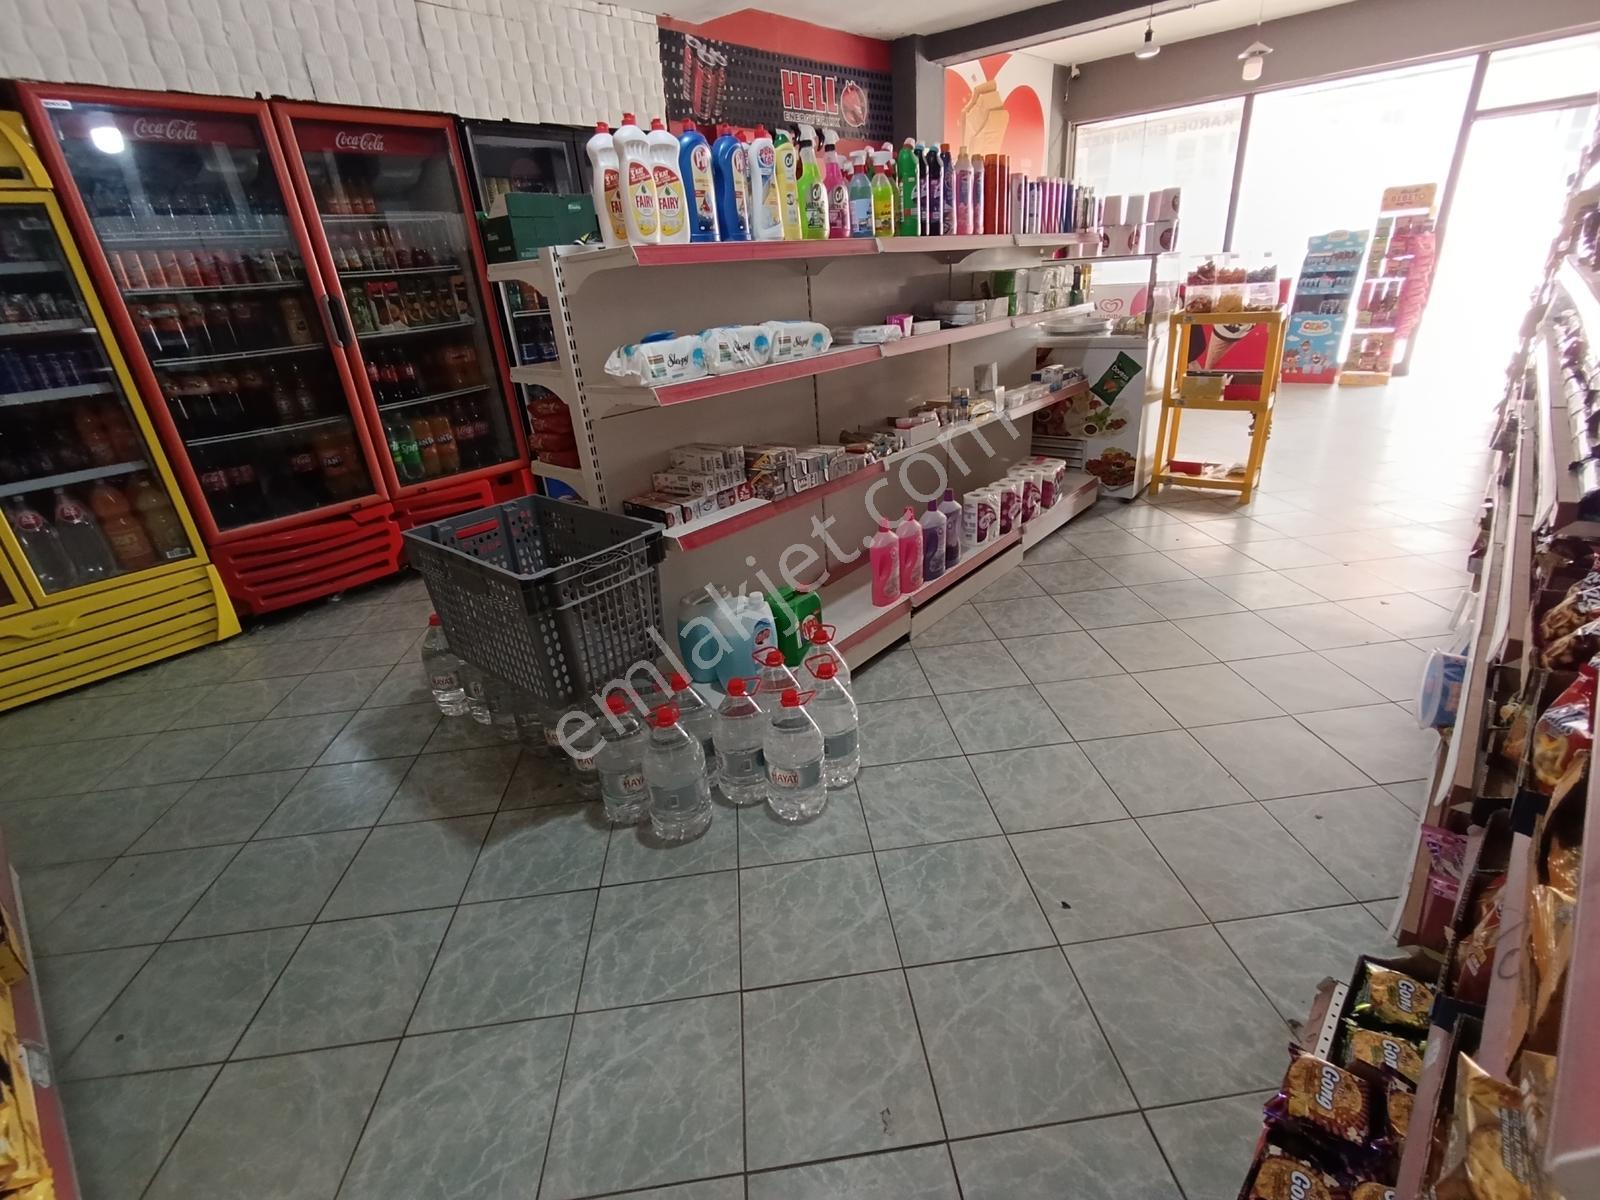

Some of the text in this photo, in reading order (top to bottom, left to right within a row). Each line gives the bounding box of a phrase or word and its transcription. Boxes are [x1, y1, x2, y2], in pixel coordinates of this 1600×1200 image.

[780, 69, 838, 115] HELL
[611, 201, 622, 213] FAI
[635, 195, 653, 209] FAIRY
[659, 197, 679, 210] FAIRY
[1382, 1040, 1401, 1070] Gon
[1315, 1065, 1341, 1111] Gong
